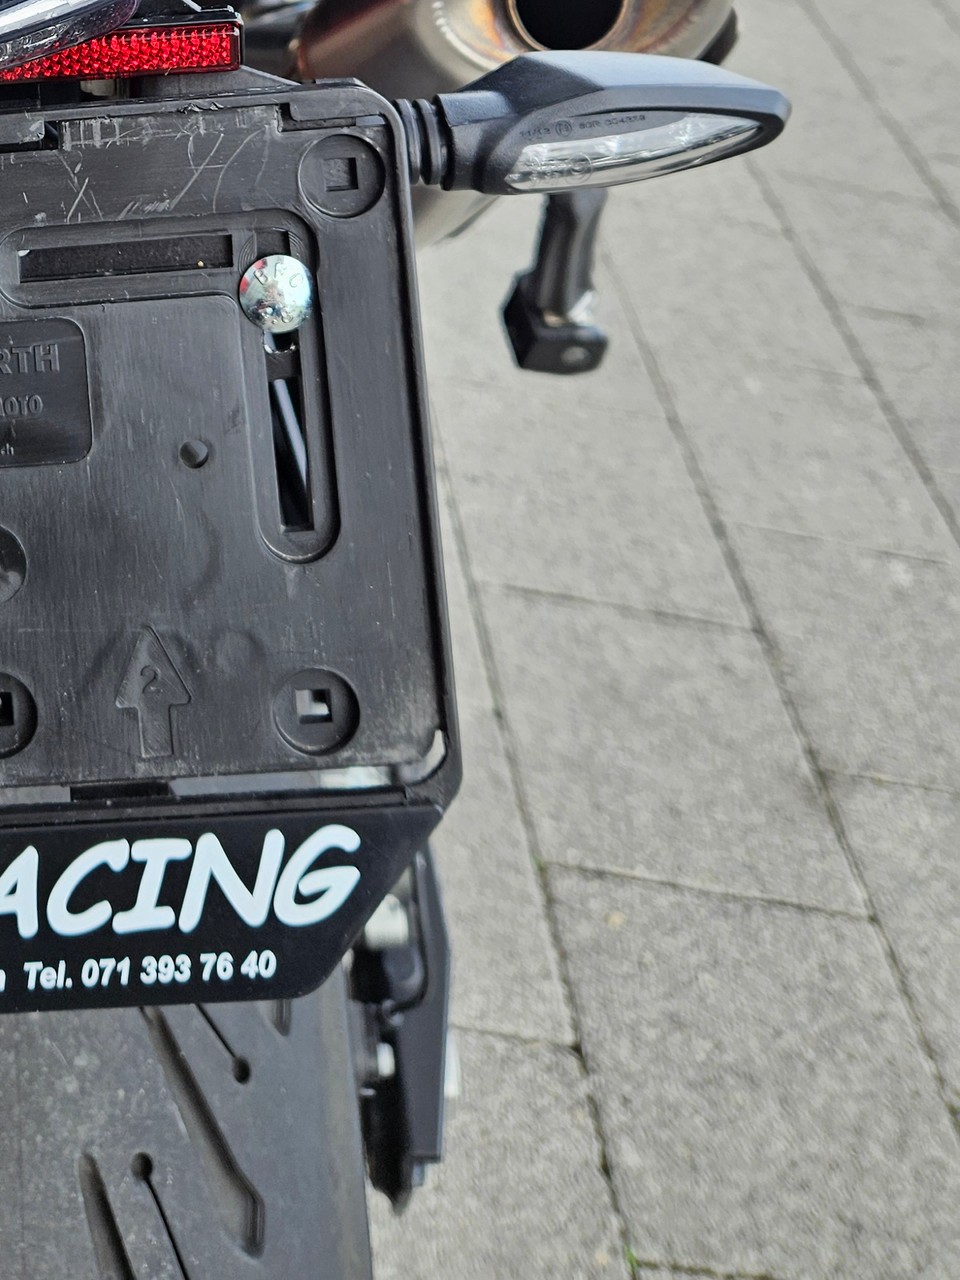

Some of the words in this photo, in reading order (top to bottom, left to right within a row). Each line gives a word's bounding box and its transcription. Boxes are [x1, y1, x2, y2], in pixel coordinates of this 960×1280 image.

[23, 960, 73, 991] Tel.
[81, 955, 132, 988] 071
[139, 953, 191, 985] 393
[199, 951, 234, 981] 76
[240, 949, 278, 980] 40
